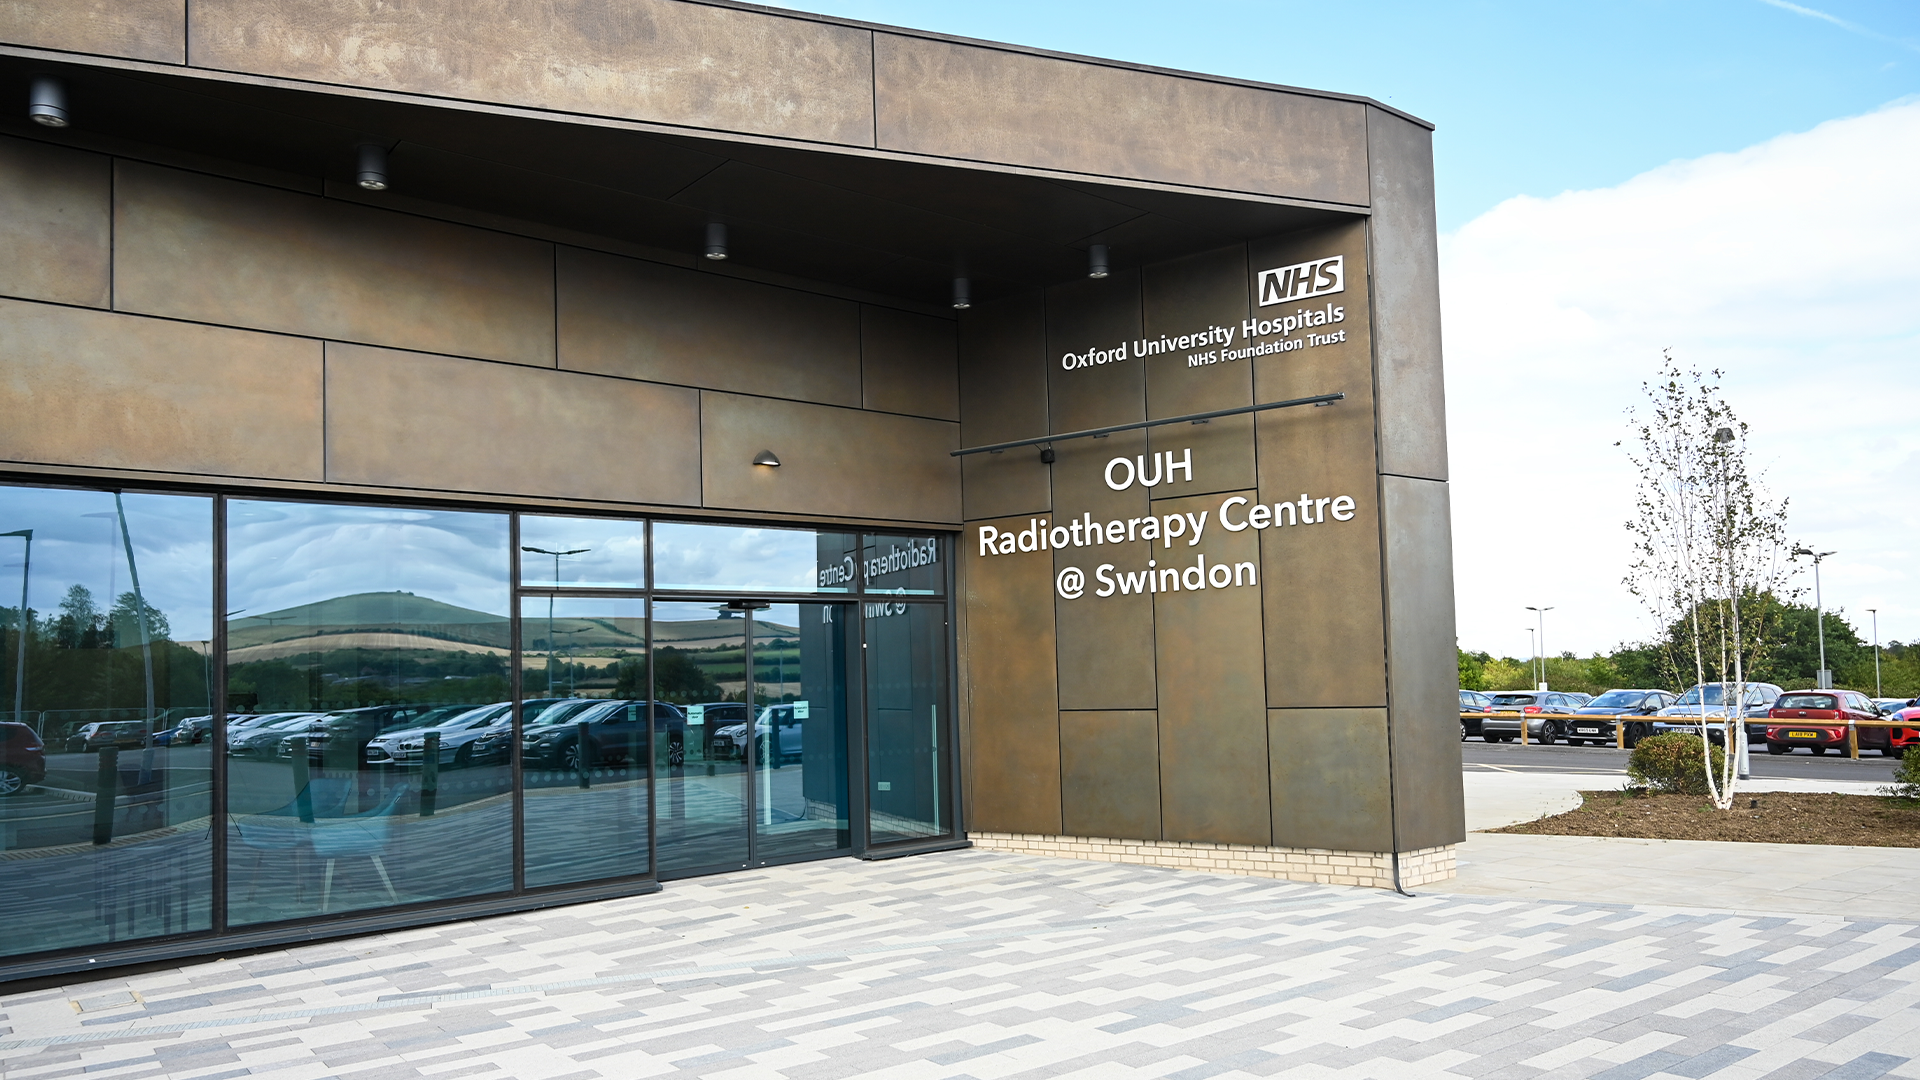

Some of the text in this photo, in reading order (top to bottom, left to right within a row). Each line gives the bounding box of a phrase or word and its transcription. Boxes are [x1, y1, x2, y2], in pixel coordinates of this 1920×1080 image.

[1262, 259, 1340, 303] NHS
[1061, 303, 1346, 372] Oxford University Hospitals
[1187, 329, 1347, 369] NHS Foundation Trust
[1104, 448, 1194, 492] OUH
[978, 493, 1357, 557] Radiotherapy Centre
[1056, 554, 1259, 600] @ Swindon
